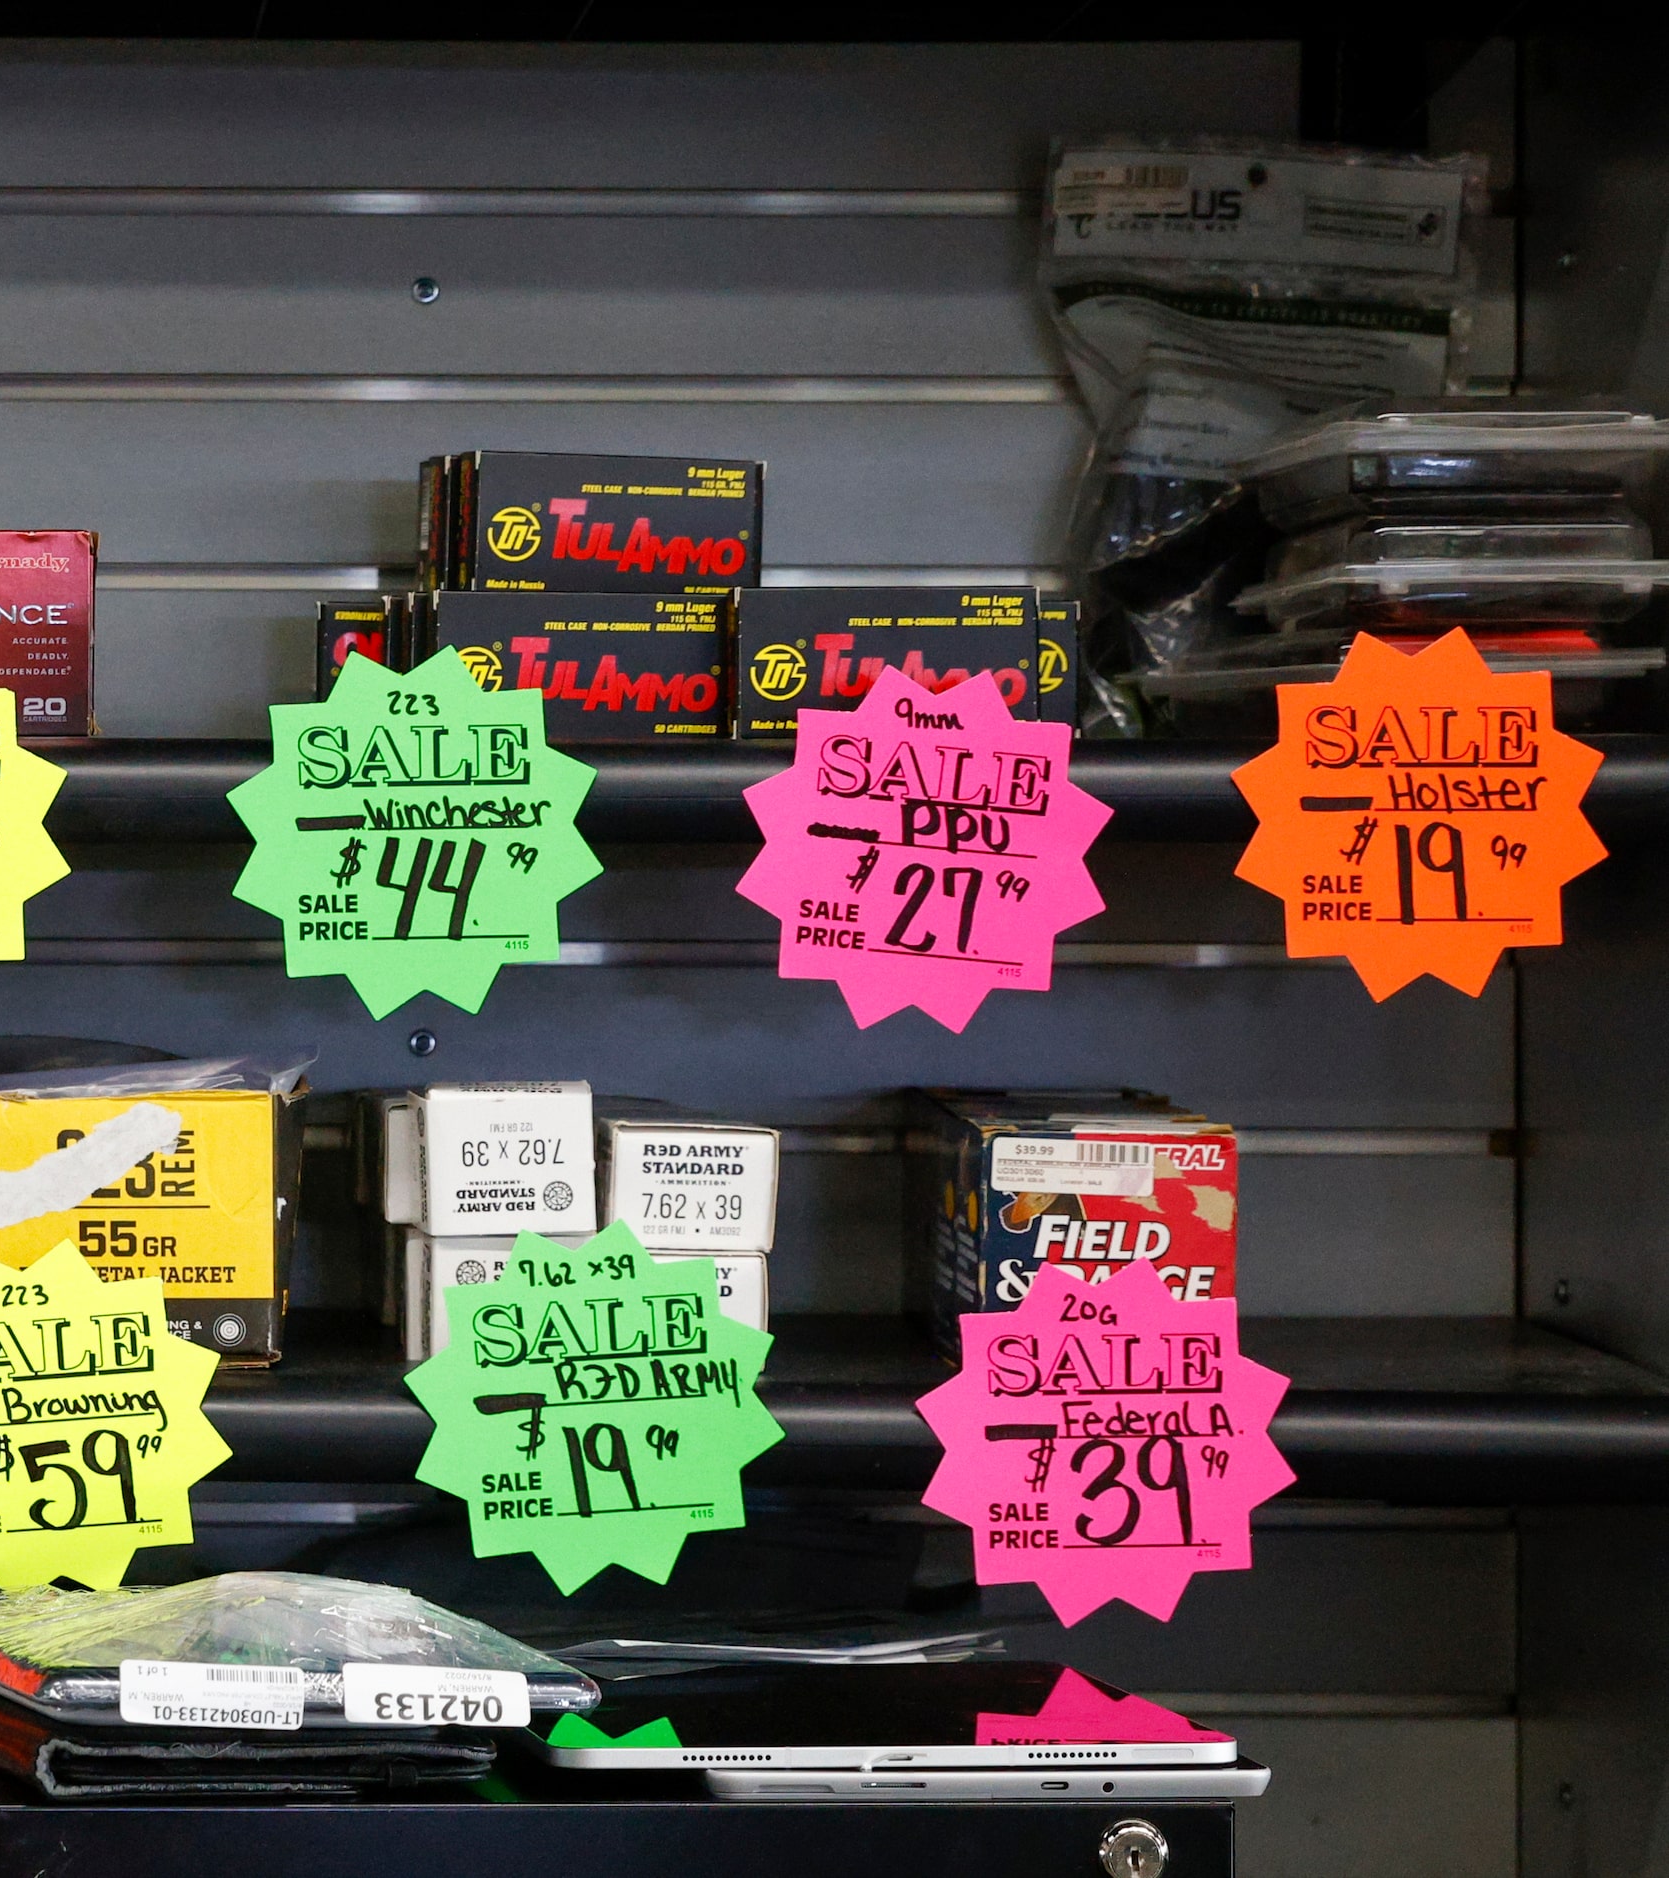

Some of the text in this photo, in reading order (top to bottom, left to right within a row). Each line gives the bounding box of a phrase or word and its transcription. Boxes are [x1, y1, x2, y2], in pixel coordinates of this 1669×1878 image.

[687, 467, 695, 478] 9
[23, 698, 66, 716] 20
[387, 691, 440, 716] 223
[894, 697, 964, 730] 9mm
[1305, 705, 1539, 769] SALE
[297, 724, 531, 790] SALE
[816, 734, 1051, 816] SALE
[1388, 772, 1548, 814] Holster
[363, 796, 551, 829] Winchester
[1302, 875, 1363, 894] SALE
[298, 894, 358, 914] SALE
[799, 899, 860, 923] SALE
[1302, 902, 1372, 921] PRICE
[299, 921, 368, 941] PRICE
[796, 925, 866, 951] PRICE
[504, 941, 529, 950] 4115
[997, 967, 1022, 978] 4115
[462, 1141, 490, 1167] 39
[518, 1139, 565, 1165] 7.62
[686, 1145, 744, 1158] ARMY
[1015, 1145, 1054, 1156] $39.99
[161, 1131, 195, 1197] REM
[457, 1201, 502, 1213] ARMY
[642, 1194, 686, 1220] 7.62
[715, 1195, 742, 1220] 39
[79, 1221, 177, 1257] 55 GR
[1033, 1215, 1171, 1260] FIELD
[160, 1266, 236, 1283] JACKET
[518, 1260, 577, 1287] 7.62
[2, 1284, 49, 1307] 223
[1060, 1294, 1117, 1325] 20G
[473, 1292, 708, 1368] SALE
[987, 1333, 1223, 1397] SALE
[650, 1358, 742, 1408] ARMY
[1, 1387, 168, 1432] Browning
[1061, 1400, 1199, 1437] Federal
[482, 1472, 542, 1494] SALE
[484, 1498, 553, 1520] PRICE
[690, 1509, 714, 1519] 4115
[989, 1503, 1049, 1521] SALE
[138, 1524, 163, 1534] 4115
[989, 1530, 1059, 1549] PRICE
[153, 1705, 300, 1726] LT-UD3042133-01
[374, 1692, 503, 1723] 042133
